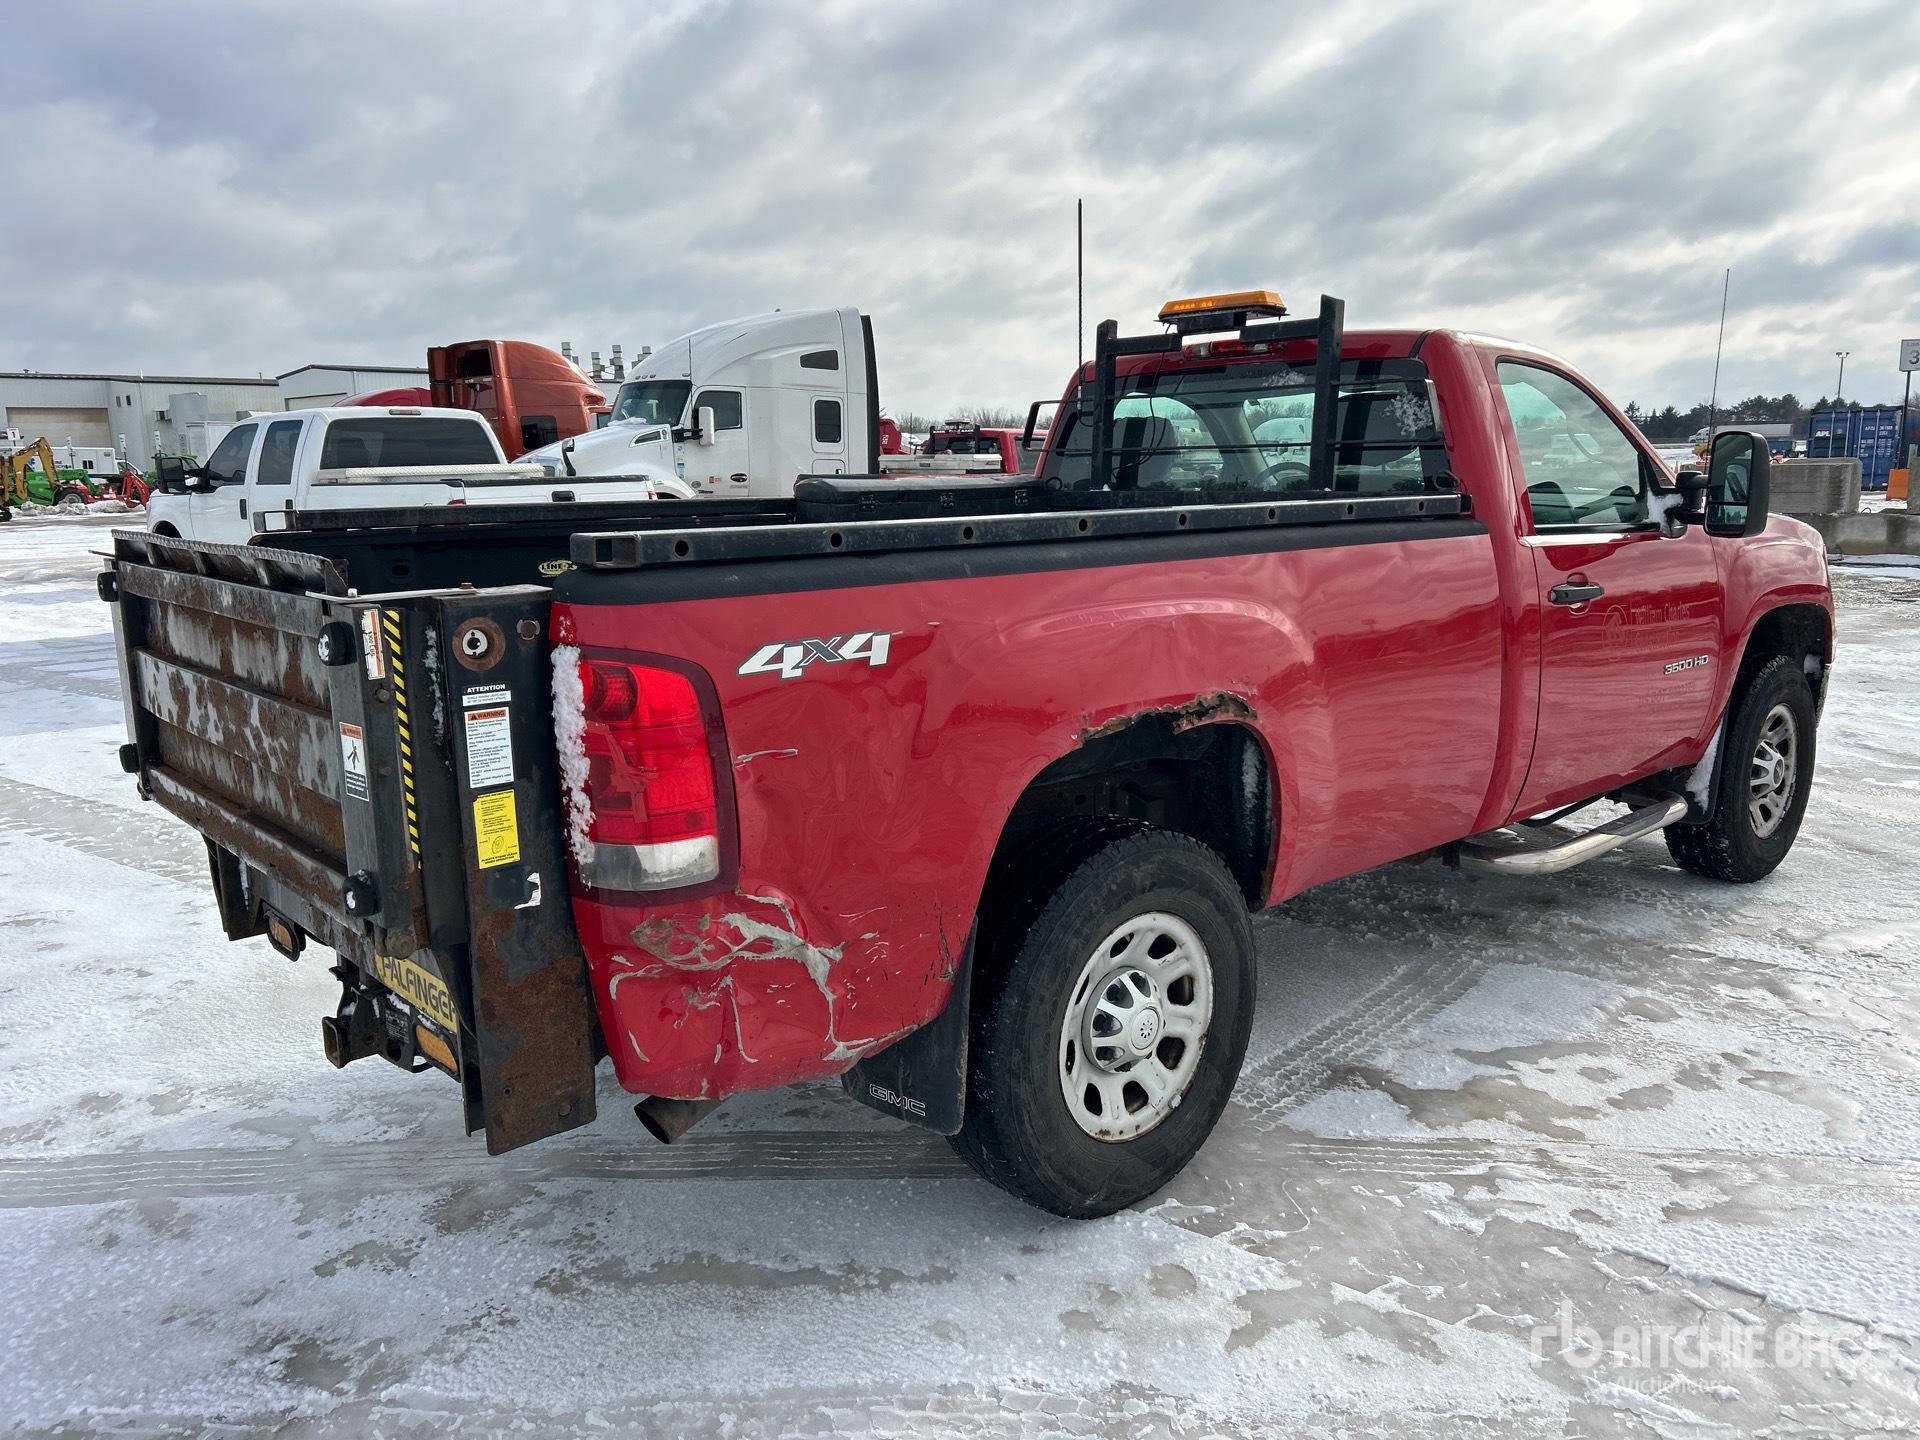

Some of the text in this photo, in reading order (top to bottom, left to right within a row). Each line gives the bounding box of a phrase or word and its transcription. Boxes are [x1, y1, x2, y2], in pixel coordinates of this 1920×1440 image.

[1908, 349, 1920, 365] 3
[1664, 654, 1709, 675] 3500 HD
[467, 684, 506, 693] ATTENTION
[478, 710, 505, 719] WARNING
[869, 1083, 926, 1116] GMC
